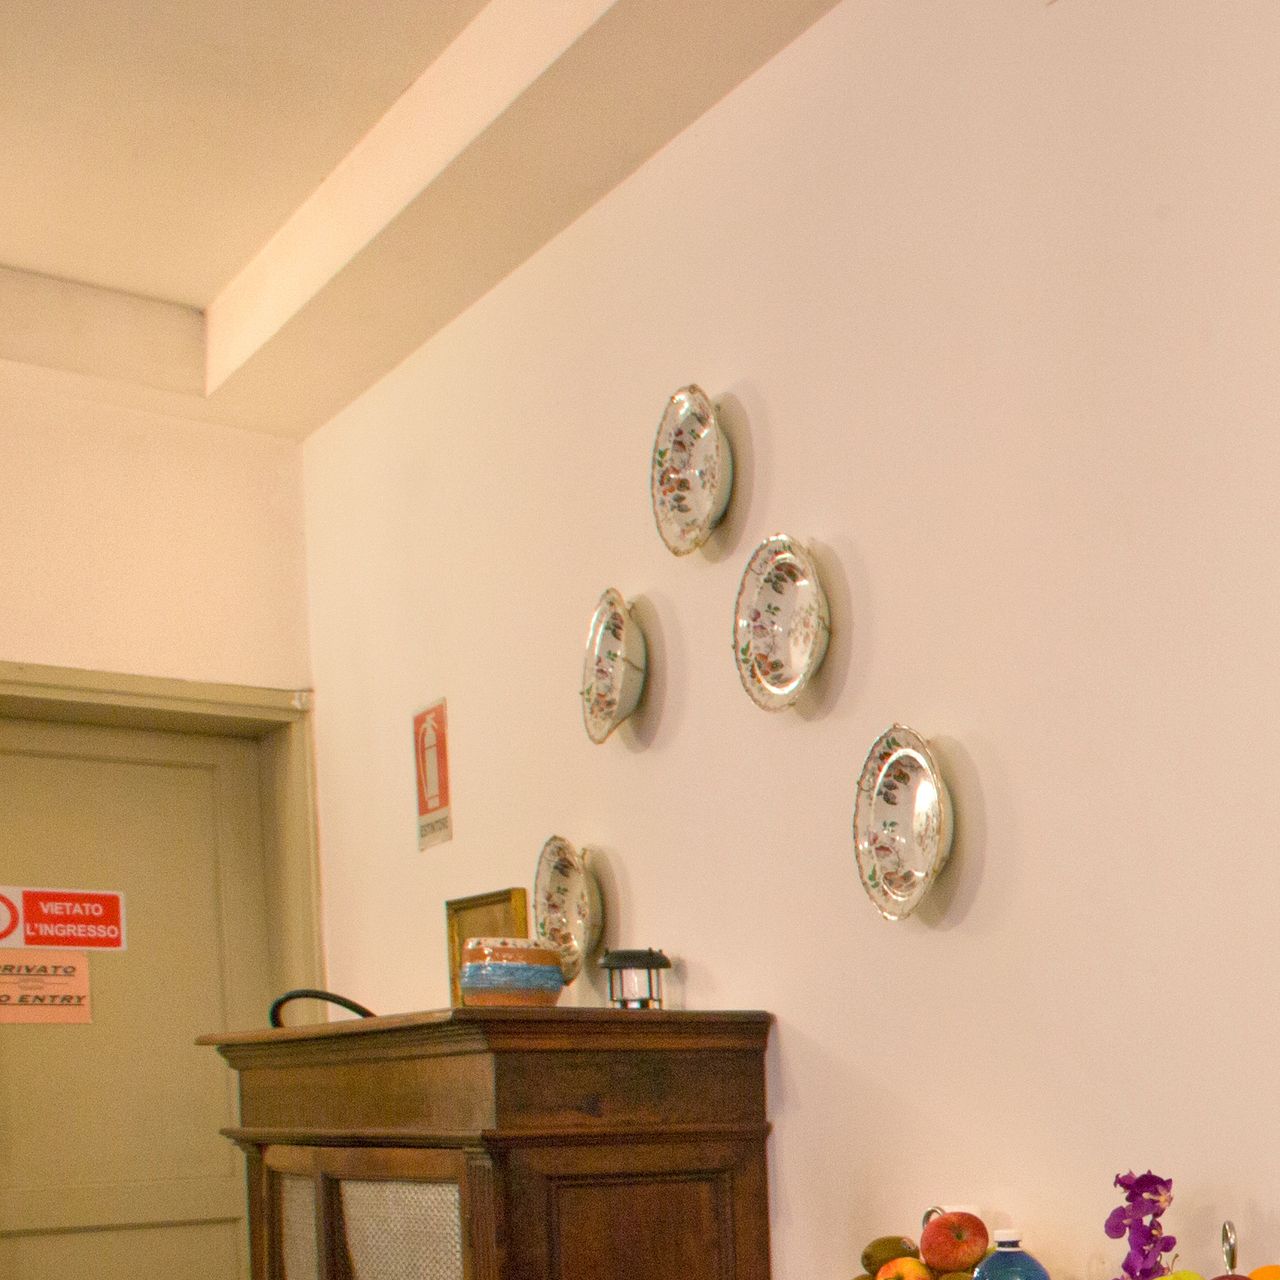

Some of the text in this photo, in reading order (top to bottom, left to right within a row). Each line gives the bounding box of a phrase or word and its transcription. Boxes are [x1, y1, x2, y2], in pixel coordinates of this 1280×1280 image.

[39, 901, 104, 916] VIETATO
[25, 922, 119, 938] L'INGRESSO
[0, 964, 77, 974] RIVATO
[18, 994, 86, 1004] ENTRY
